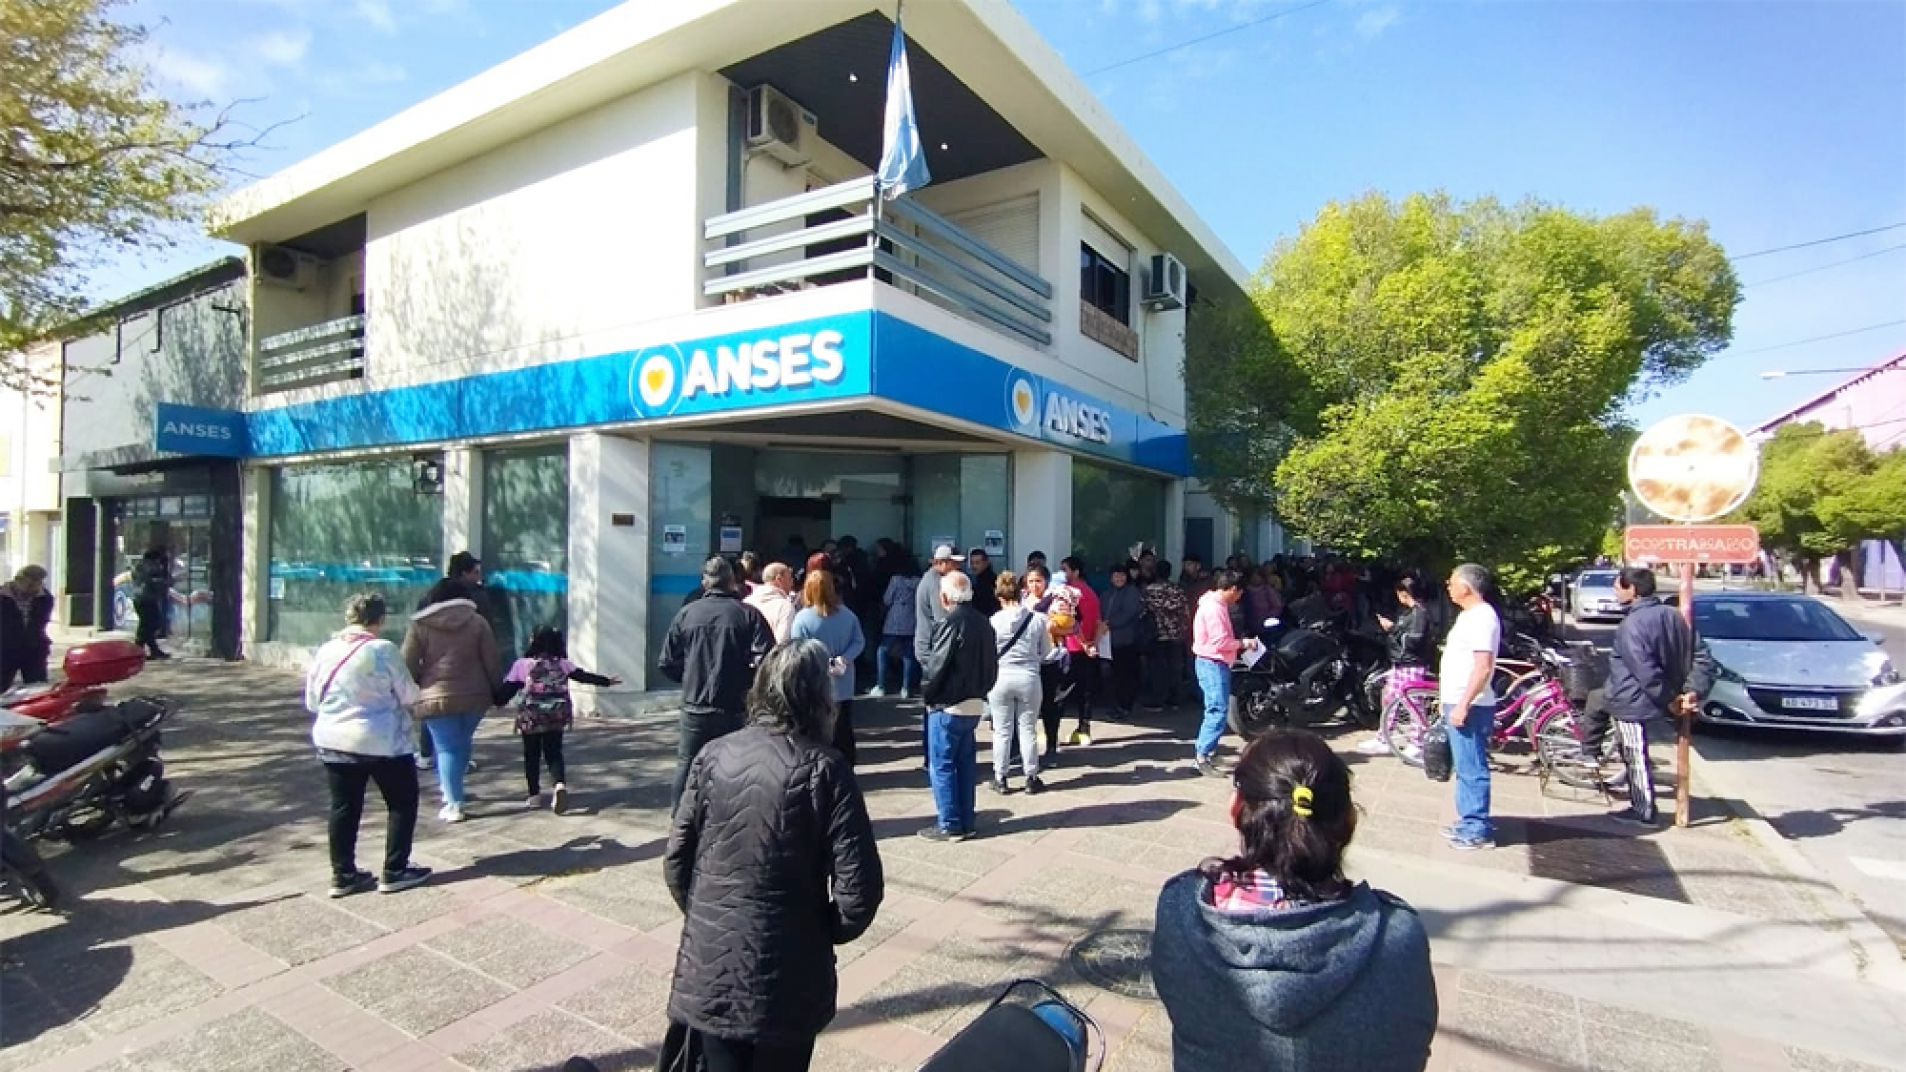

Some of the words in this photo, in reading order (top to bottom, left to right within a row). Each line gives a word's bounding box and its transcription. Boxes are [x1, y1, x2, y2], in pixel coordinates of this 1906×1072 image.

[682, 329, 845, 398] ANSES
[163, 420, 232, 440] ANSES
[1043, 391, 1112, 443] ANSES
